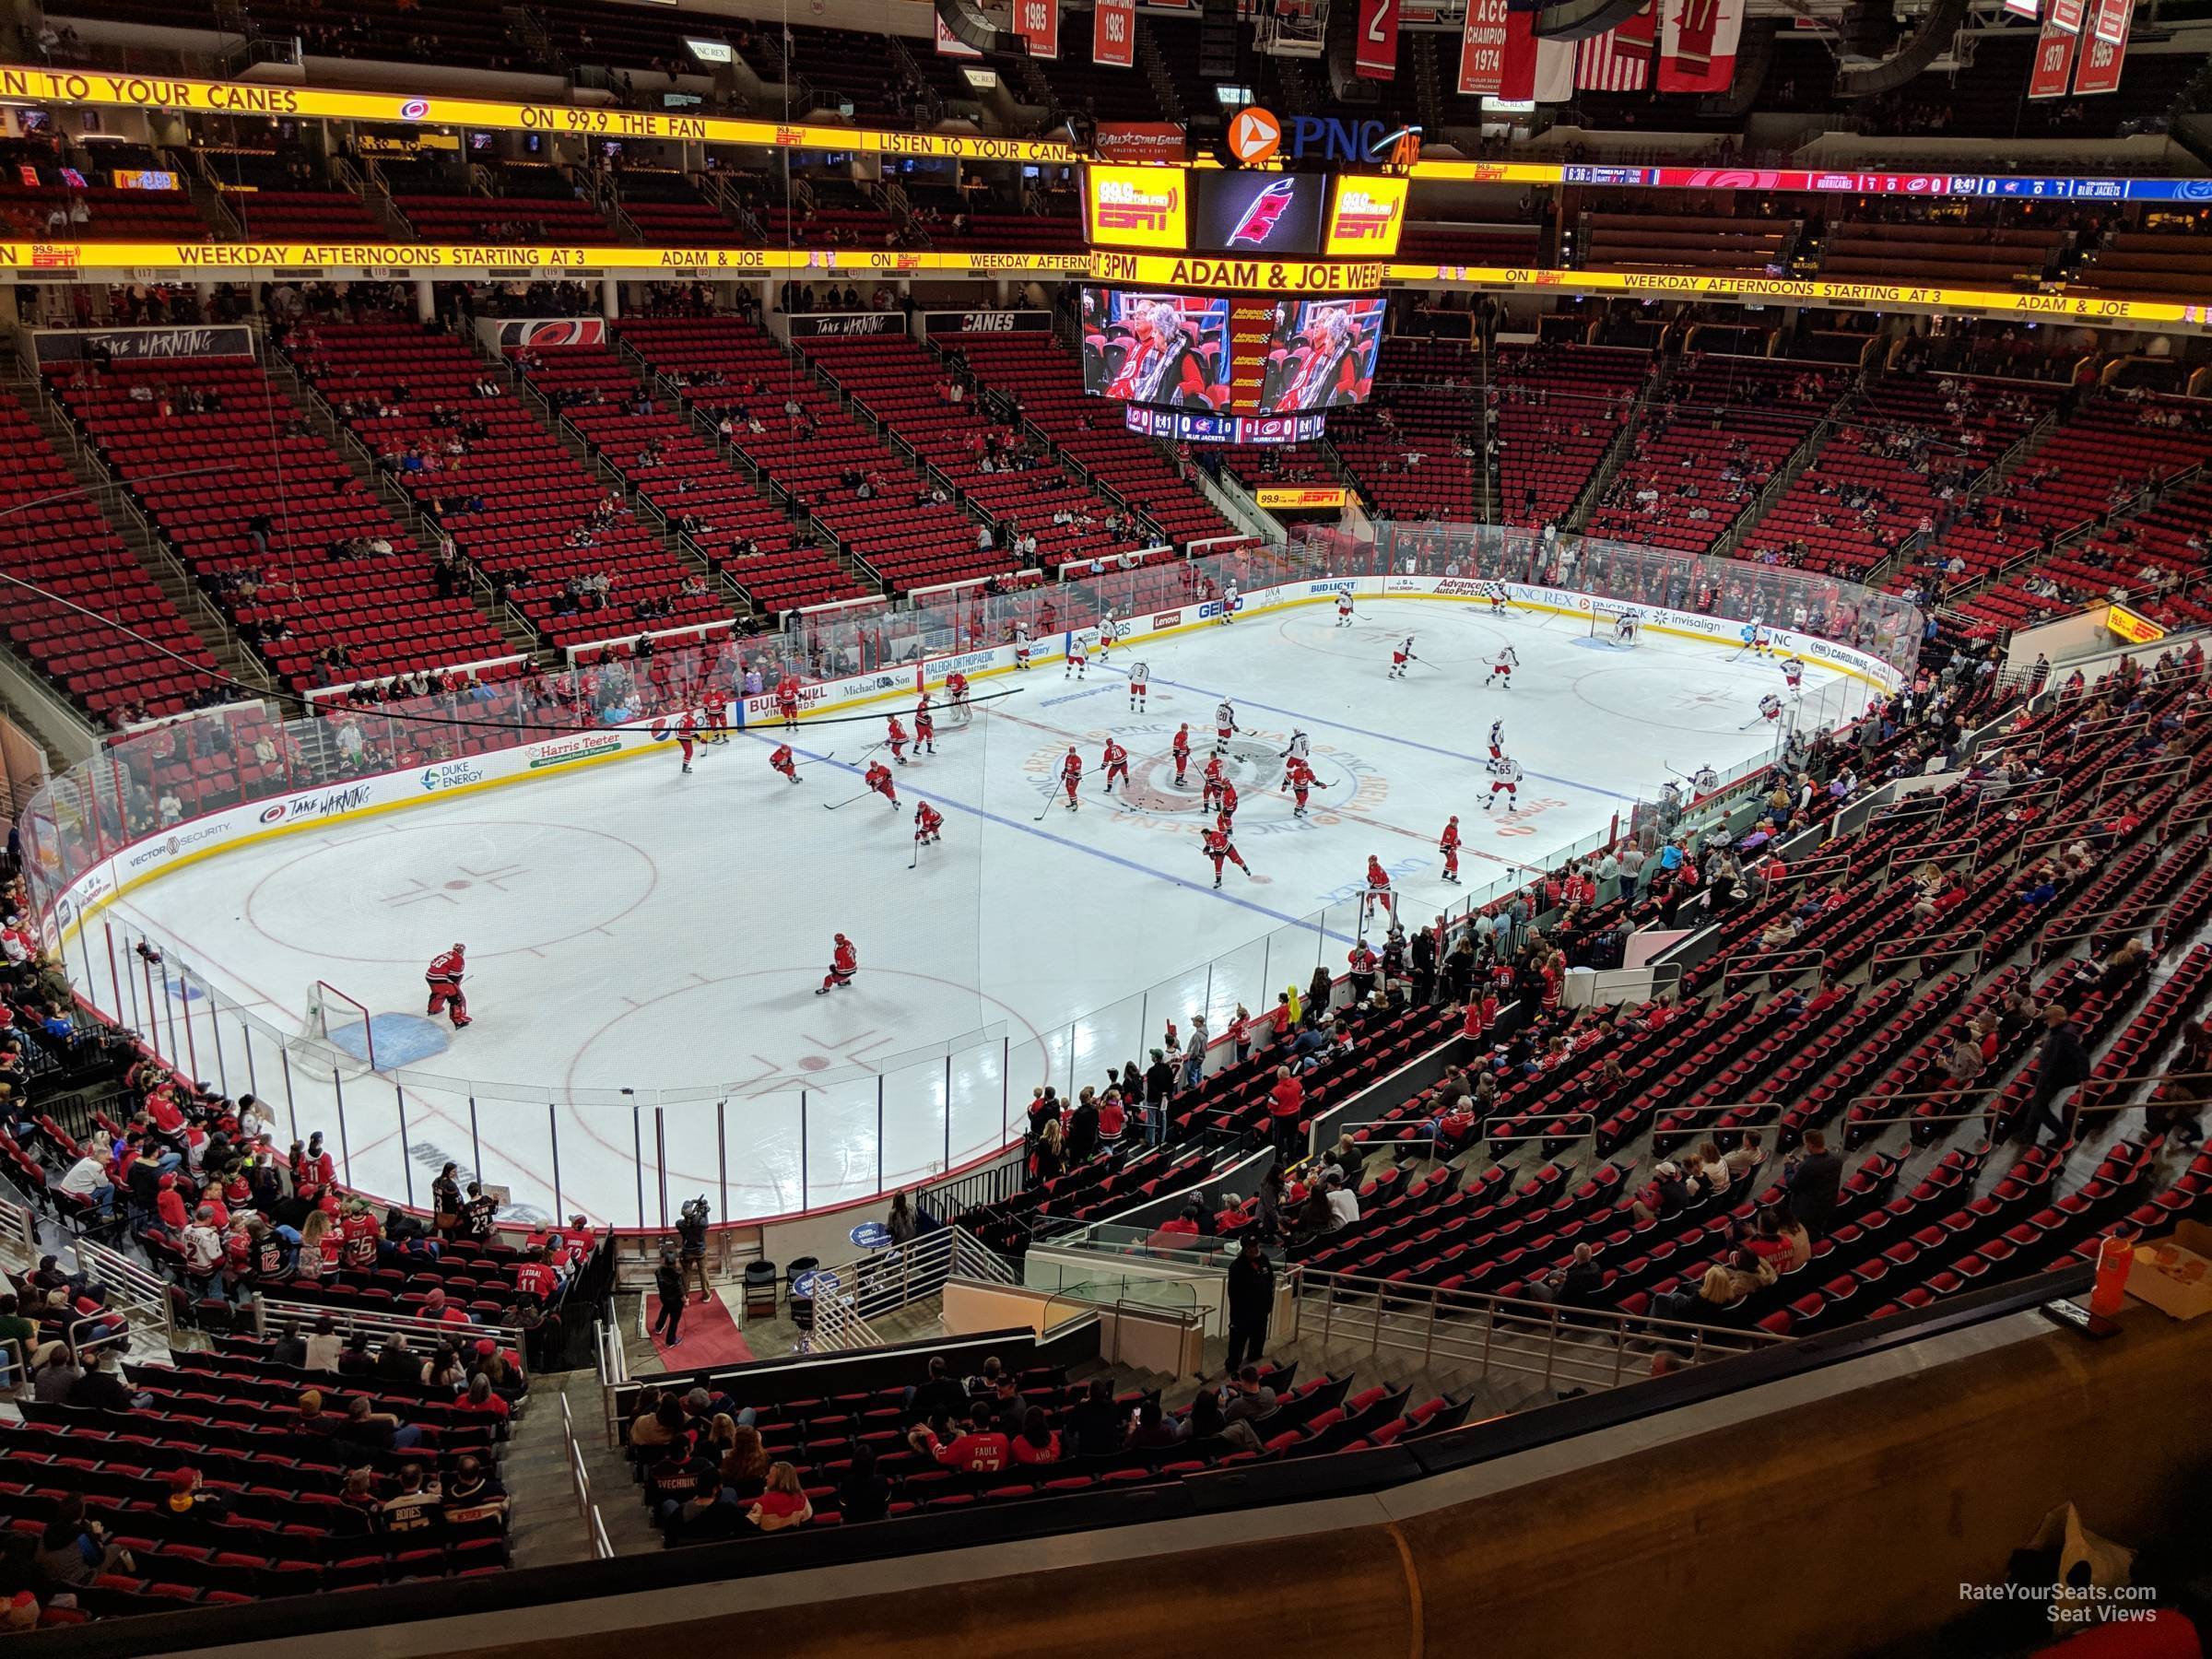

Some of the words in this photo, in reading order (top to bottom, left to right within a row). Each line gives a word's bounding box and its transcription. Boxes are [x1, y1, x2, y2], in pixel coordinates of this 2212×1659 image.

[1025, 3, 1046, 31] 1985
[1477, 0, 1507, 23] ACC
[1105, 13, 1124, 43] 1983
[710, 49, 725, 58] REX
[1475, 49, 1500, 71] 1974
[46, 75, 90, 100] TO
[107, 77, 191, 106] YOUR
[208, 85, 298, 113] CANES
[521, 106, 553, 129] ON
[567, 110, 608, 132] 99.9
[619, 115, 657, 135] THE
[669, 118, 706, 138] FAN
[880, 134, 932, 153] LISTEN
[944, 137, 963, 156] TO
[973, 139, 1019, 159] YOUR
[1030, 142, 1074, 162] CANE
[1291, 116, 1385, 164] PNC
[1569, 168, 1585, 181] 6:36
[1931, 179, 1941, 193] 0
[1953, 178, 1976, 190] 8:41
[1987, 180, 1996, 194] 0
[2077, 186, 2095, 195] BLUE
[2096, 186, 2121, 196] JACKETS
[32, 246, 53, 254] 99.9
[176, 247, 289, 265] WEEKDAY
[303, 247, 441, 265] AFTERNOONS
[452, 248, 539, 265] STARTING
[551, 249, 570, 265] AT
[575, 250, 585, 265] 3
[661, 251, 709, 266] ADAM
[717, 252, 728, 266] &
[736, 252, 764, 266] JOE
[871, 254, 891, 267] ON
[970, 254, 1030, 268] WEEKDAY
[1091, 258, 1100, 276] AT
[1104, 255, 1137, 280] 3PM
[1170, 259, 1259, 288] ADAM
[1268, 264, 1287, 288] &
[1295, 265, 1340, 290] JOE
[1506, 270, 1529, 282] ON
[1624, 275, 1698, 291] WEEKDAY
[1706, 278, 1814, 296] AFTERNOONS
[1824, 284, 1900, 301] STARTING
[1909, 289, 1928, 301] AT
[1931, 291, 1941, 303] 3
[2016, 296, 2067, 312] ADAM
[2076, 300, 2087, 314] &
[2097, 301, 2130, 316] JOE
[817, 318, 839, 335] TAKE
[843, 316, 885, 336] WARNING
[962, 314, 1015, 331] CANES
[139, 330, 216, 359] WARNING
[1142, 411, 1148, 426] 0
[1182, 417, 1190, 432] 0
[1225, 423, 1231, 432] 0
[1284, 420, 1292, 434] 0
[1260, 494, 1279, 505] 99.9
[1303, 491, 1340, 503] ESPN
[1311, 584, 1330, 593] BUD
[1433, 587, 1454, 595] Auto
[1455, 588, 1478, 597] Parts
[1439, 578, 1482, 590] Advance
[1508, 586, 1539, 600] UNC
[1544, 592, 1575, 608] REX
[1199, 598, 1243, 618] GEIO
[1154, 613, 1179, 625] Lenovo
[1671, 613, 1721, 633] invisalign
[1773, 634, 1792, 647] NC
[1030, 646, 1049, 656] ottery
[1831, 648, 1867, 671] CAROLINAS
[925, 661, 952, 675] RALEIGH
[843, 681, 876, 697] Michael
[894, 676, 910, 687] Son
[1218, 712, 1228, 722] 20
[1108, 723, 1172, 735] PNC
[541, 742, 580, 757] Harris
[582, 733, 620, 749] Teeter
[1112, 748, 1122, 758] 20
[442, 762, 469, 777] DUKE
[1499, 765, 1511, 775] 65
[443, 771, 483, 788] ENERGY
[288, 795, 317, 817] TAKE
[319, 785, 371, 817] WARNING
[129, 847, 166, 868] VECTOR
[180, 824, 229, 847] SECURITY
[1571, 888, 1582, 899] 12
[308, 1165, 318, 1183] 11
[471, 1216, 489, 1234] 23
[260, 1250, 280, 1272] 12
[520, 1278, 535, 1291] 11
[974, 1446, 997, 1457] FAULK
[1035, 1449, 1051, 1461] AHO
[396, 1506, 421, 1522] BONES
